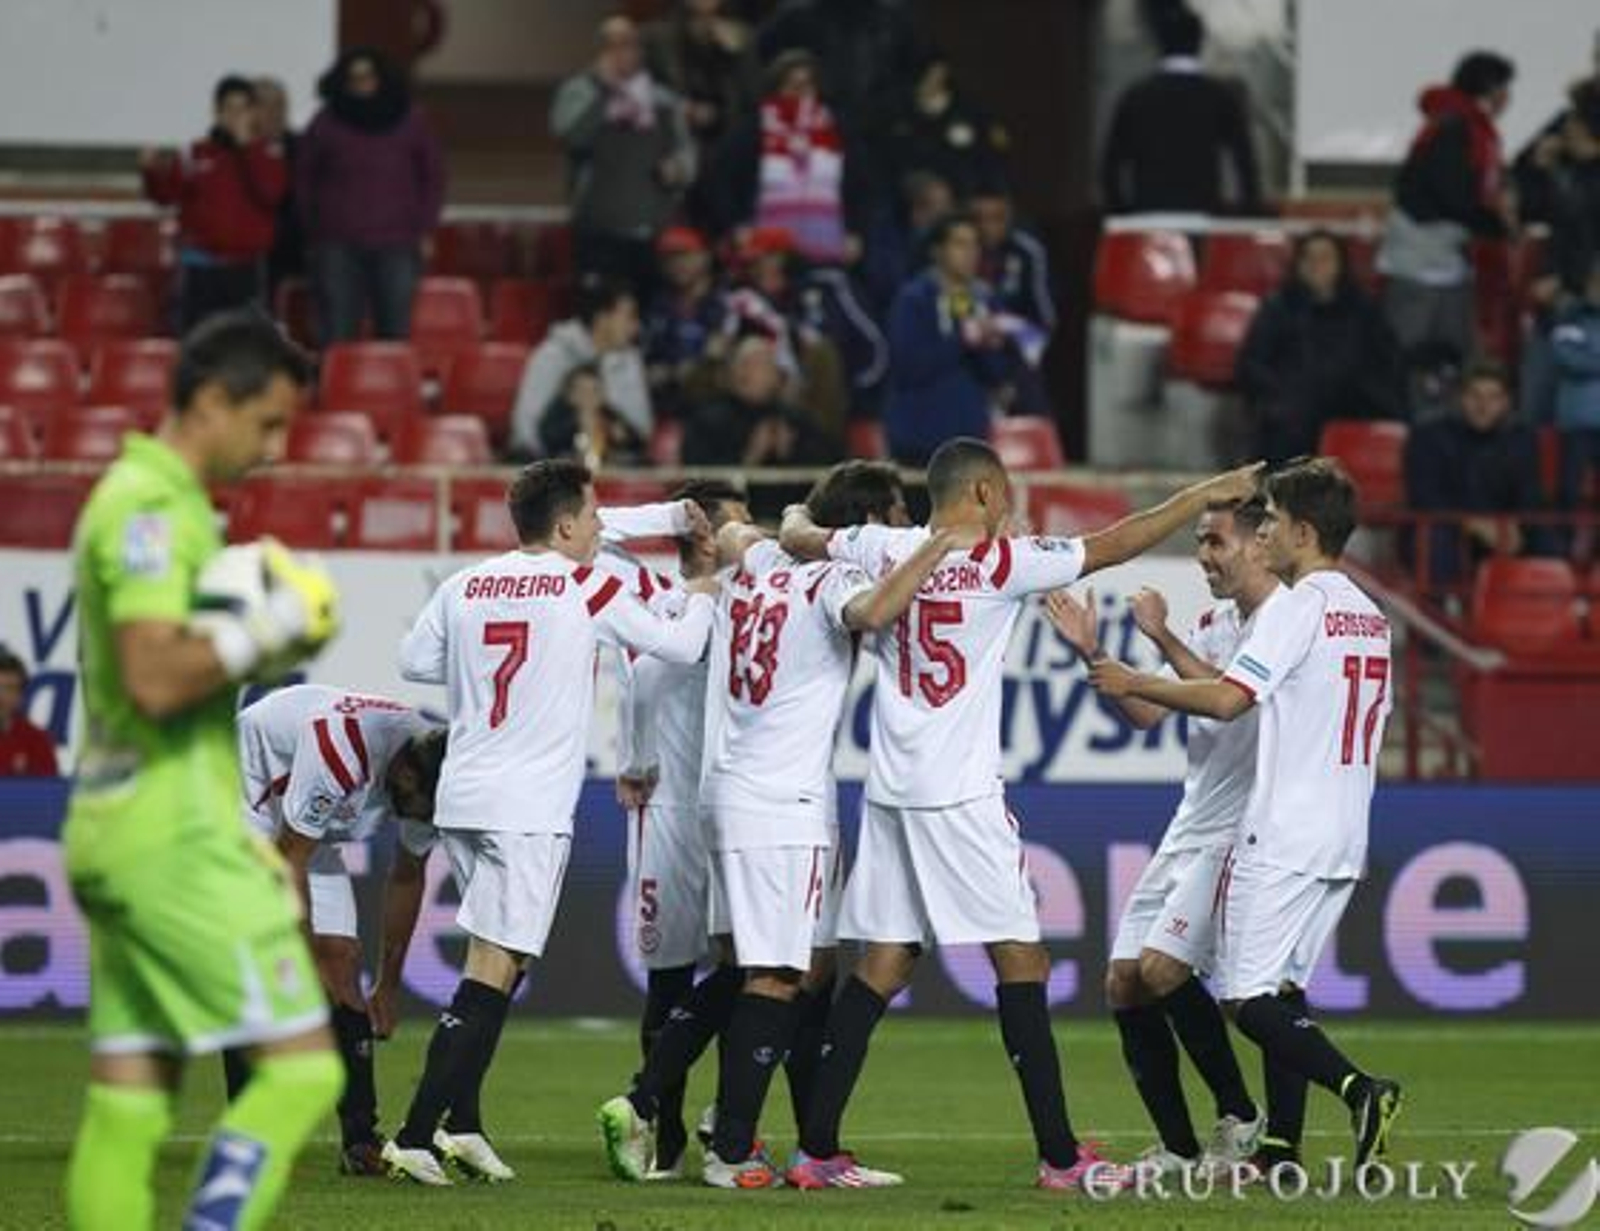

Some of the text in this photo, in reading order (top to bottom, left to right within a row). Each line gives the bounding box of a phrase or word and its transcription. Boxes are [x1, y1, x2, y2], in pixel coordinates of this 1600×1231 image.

[464, 575, 566, 599] GAMEIRO
[482, 620, 529, 730] 7
[896, 600, 966, 708] 15
[1341, 655, 1388, 765] 17
[641, 878, 658, 922] 5
